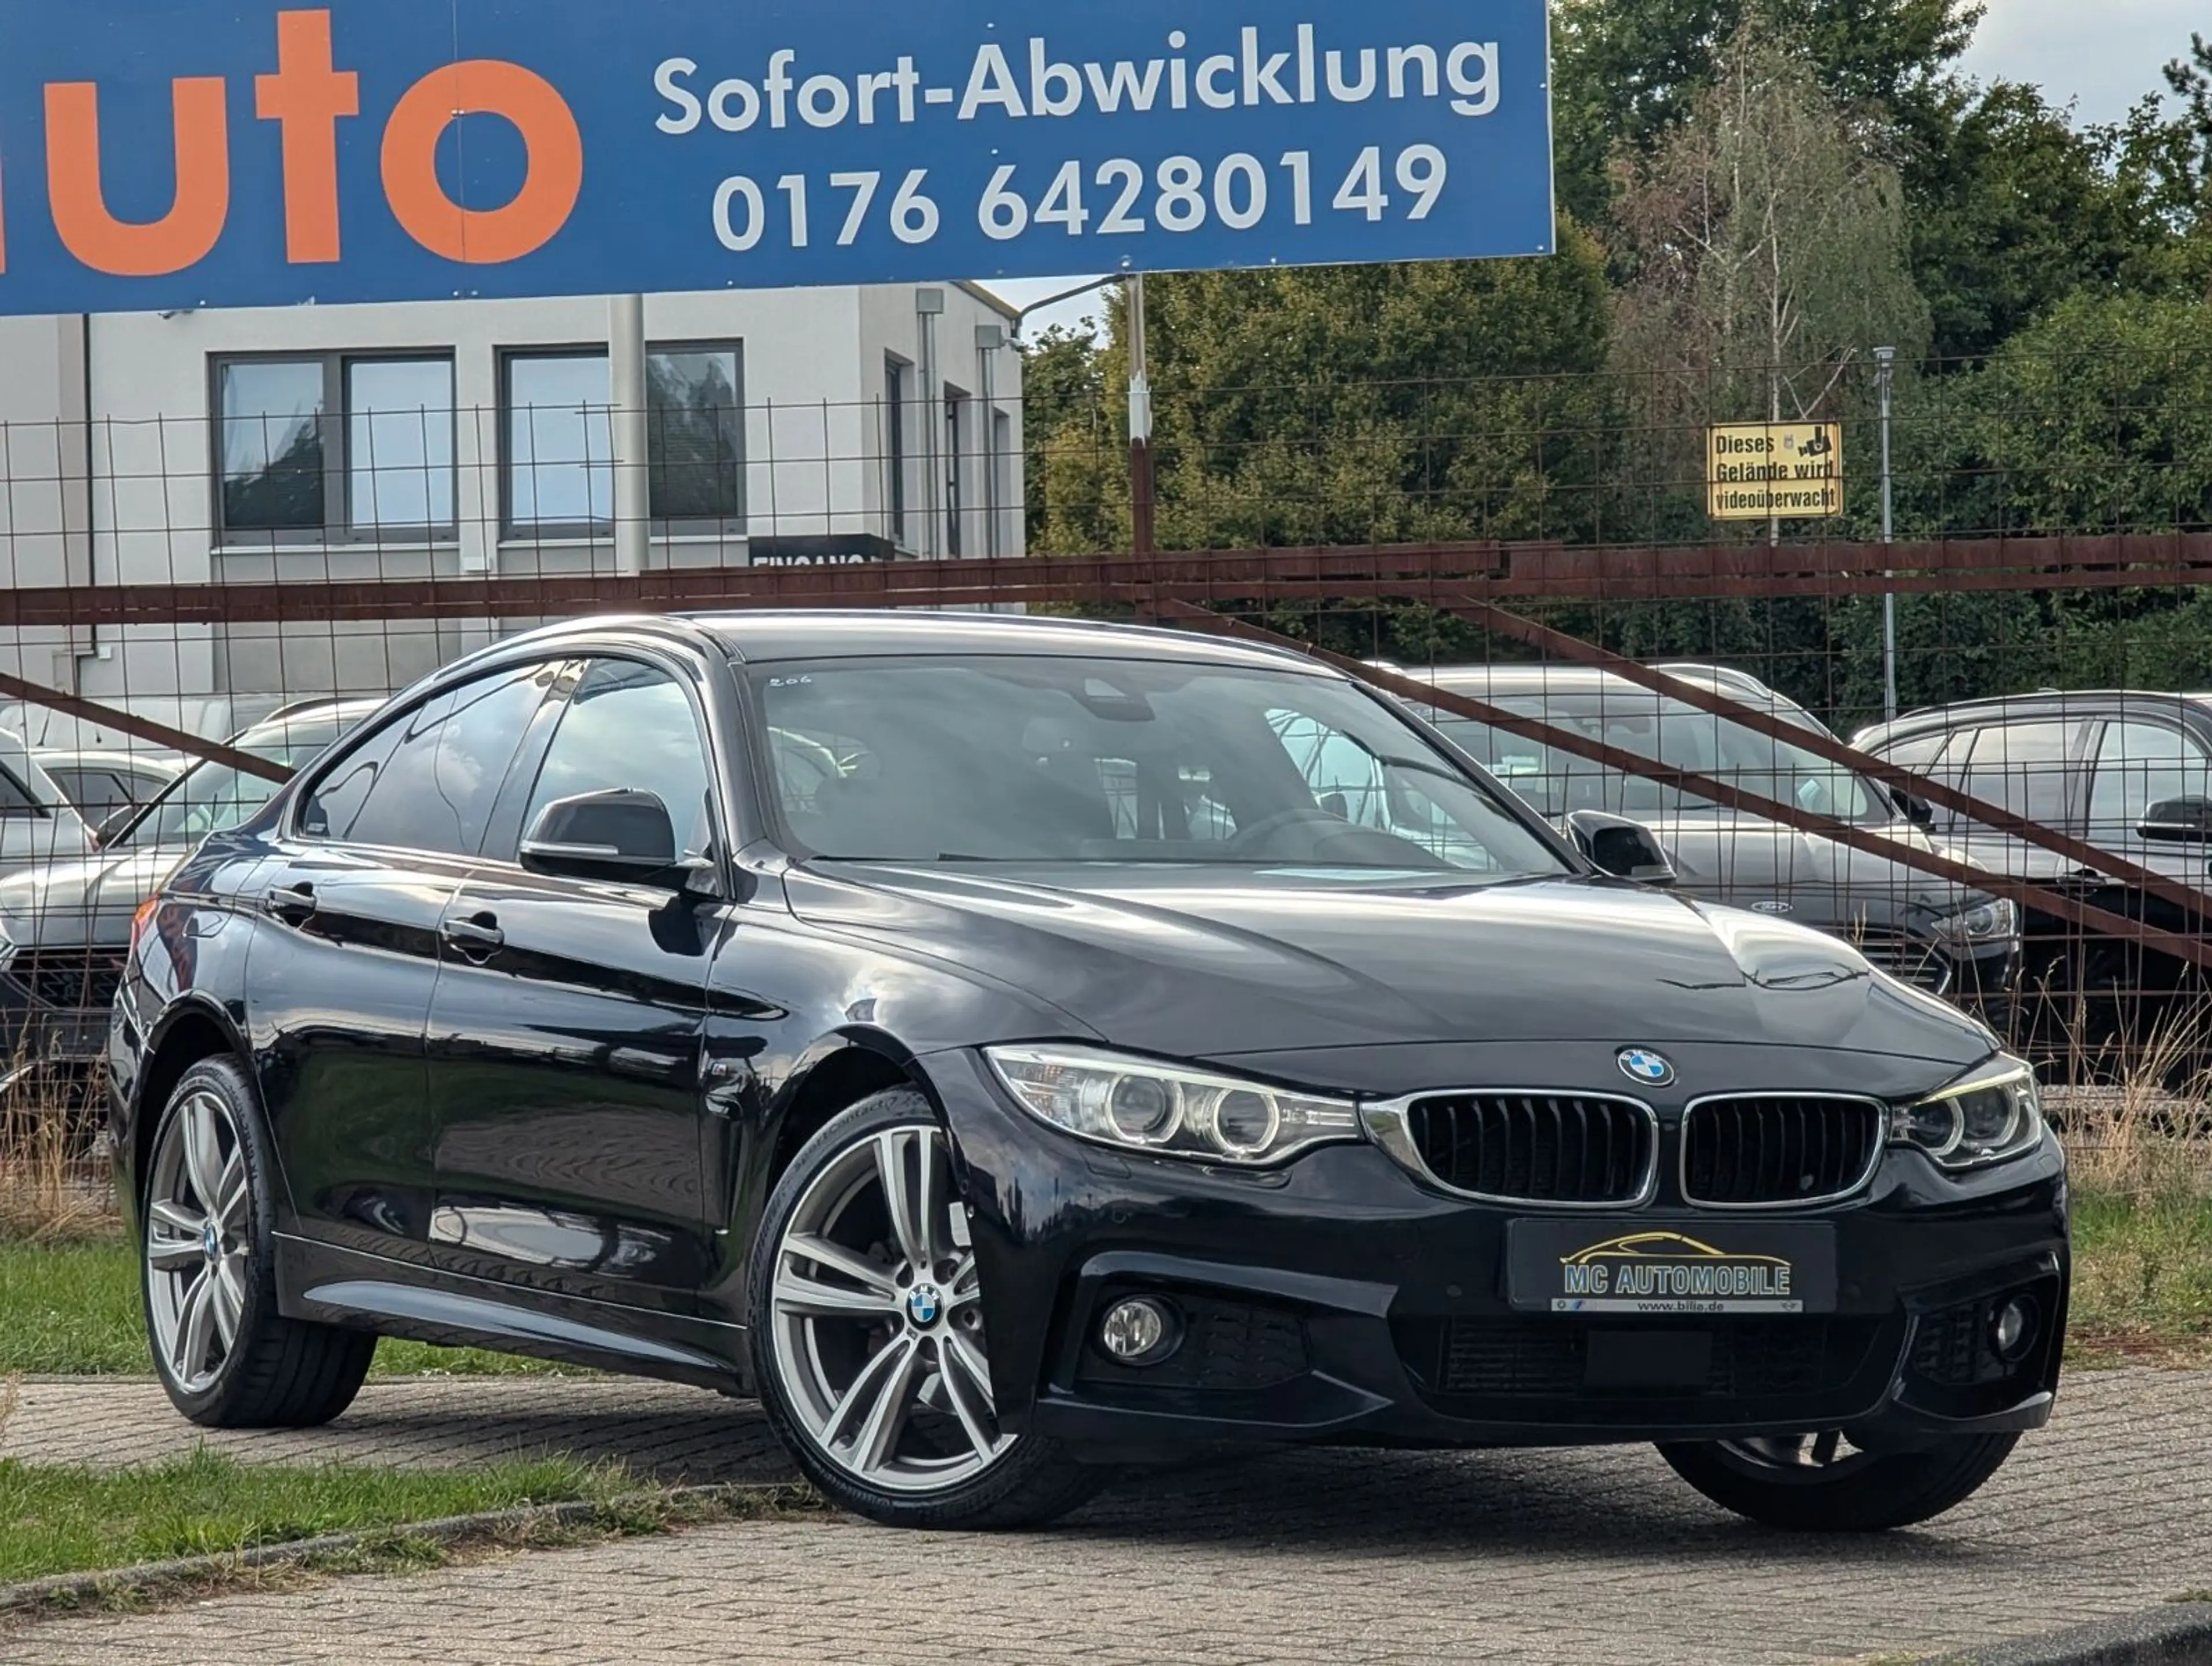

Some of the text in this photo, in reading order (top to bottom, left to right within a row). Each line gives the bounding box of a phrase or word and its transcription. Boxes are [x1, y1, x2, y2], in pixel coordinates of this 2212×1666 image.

[654, 23, 1500, 134] Sofort-Abwicklung
[0, 9, 583, 277] uto
[712, 143, 1447, 250] 0176 64280149
[1716, 435, 1774, 454] Dieses
[1717, 460, 1834, 481] Gelände wird
[1717, 489, 1834, 509] videoüberwacht
[1615, 1265, 1791, 1295] AUTOMOBILE
